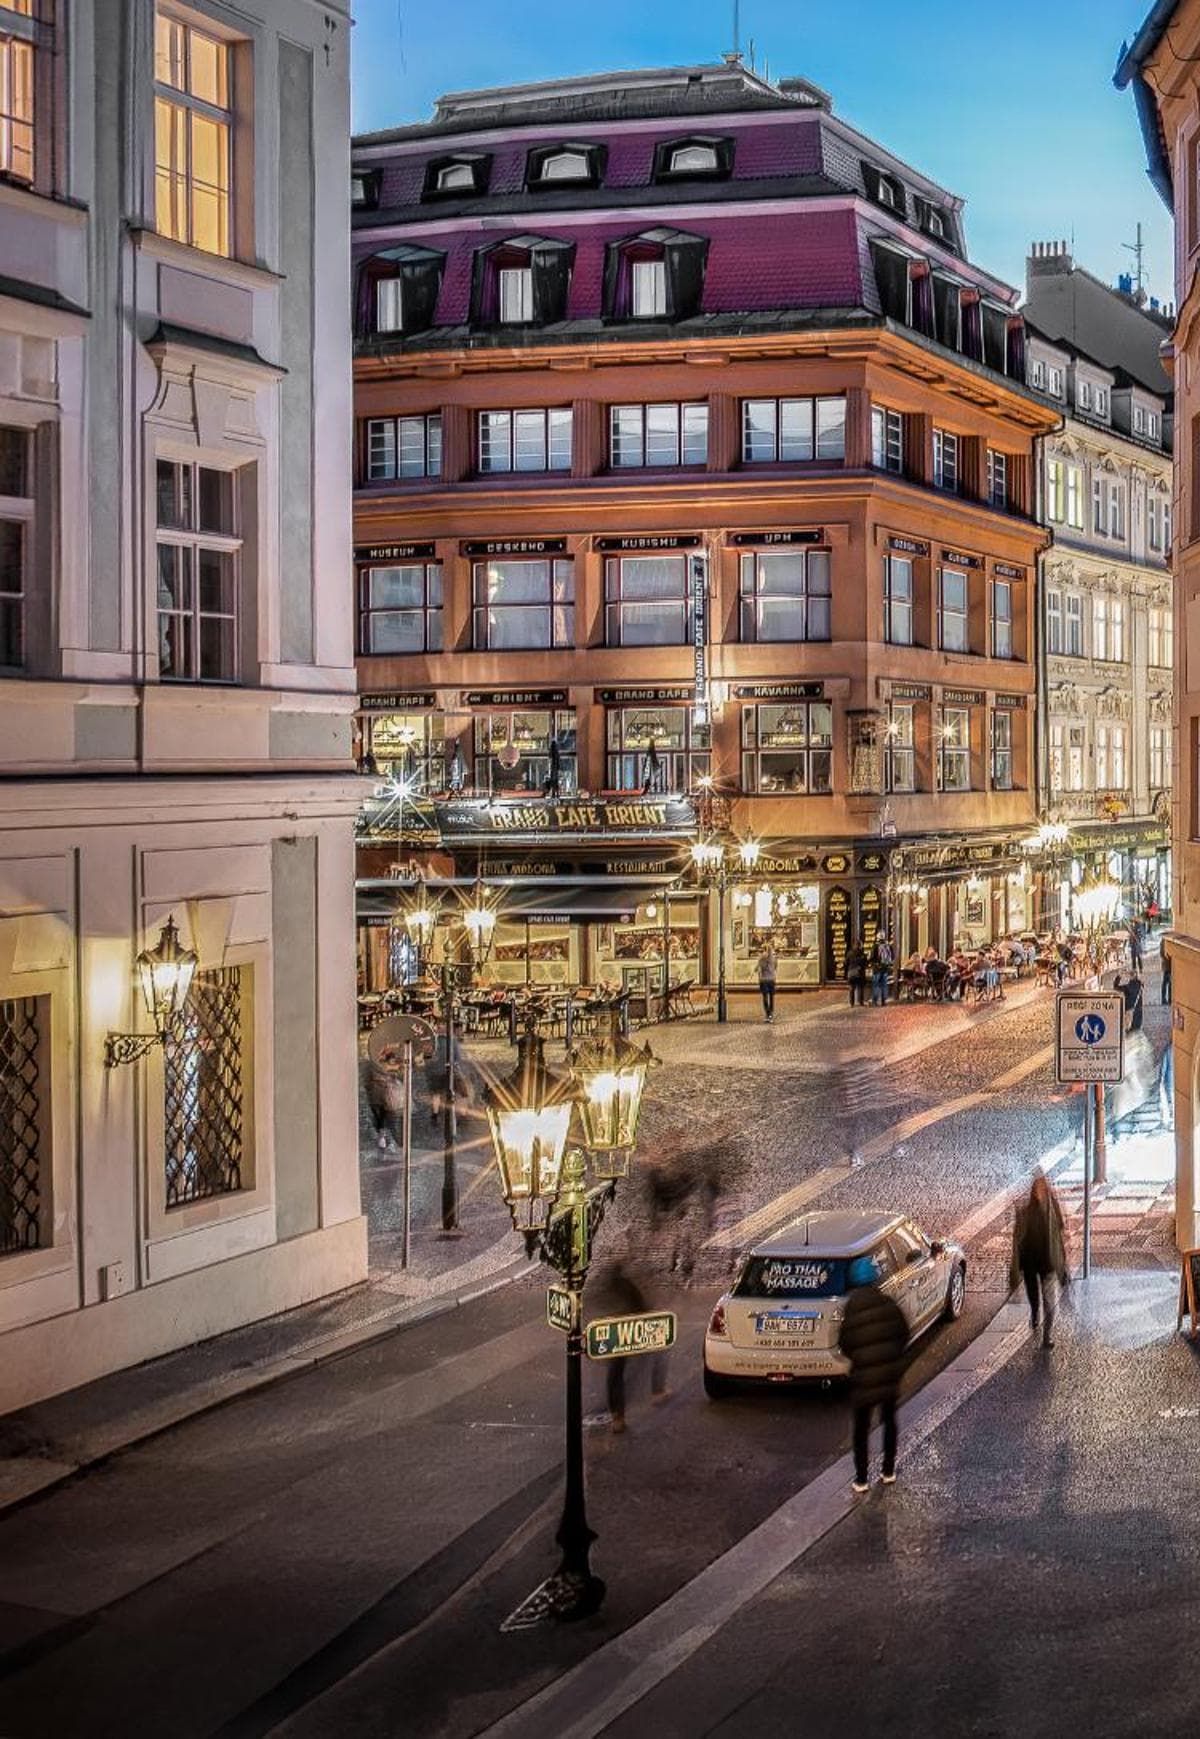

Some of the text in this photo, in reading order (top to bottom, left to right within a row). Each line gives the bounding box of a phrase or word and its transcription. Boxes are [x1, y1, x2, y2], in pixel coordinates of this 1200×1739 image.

[492, 693, 541, 703] ORIENT
[615, 690, 654, 700] GRAND
[488, 804, 549, 829] GRAND
[605, 802, 667, 826] ORIENT
[769, 1261, 821, 1276] PRO THAI
[766, 1276, 819, 1289] MASSAGE
